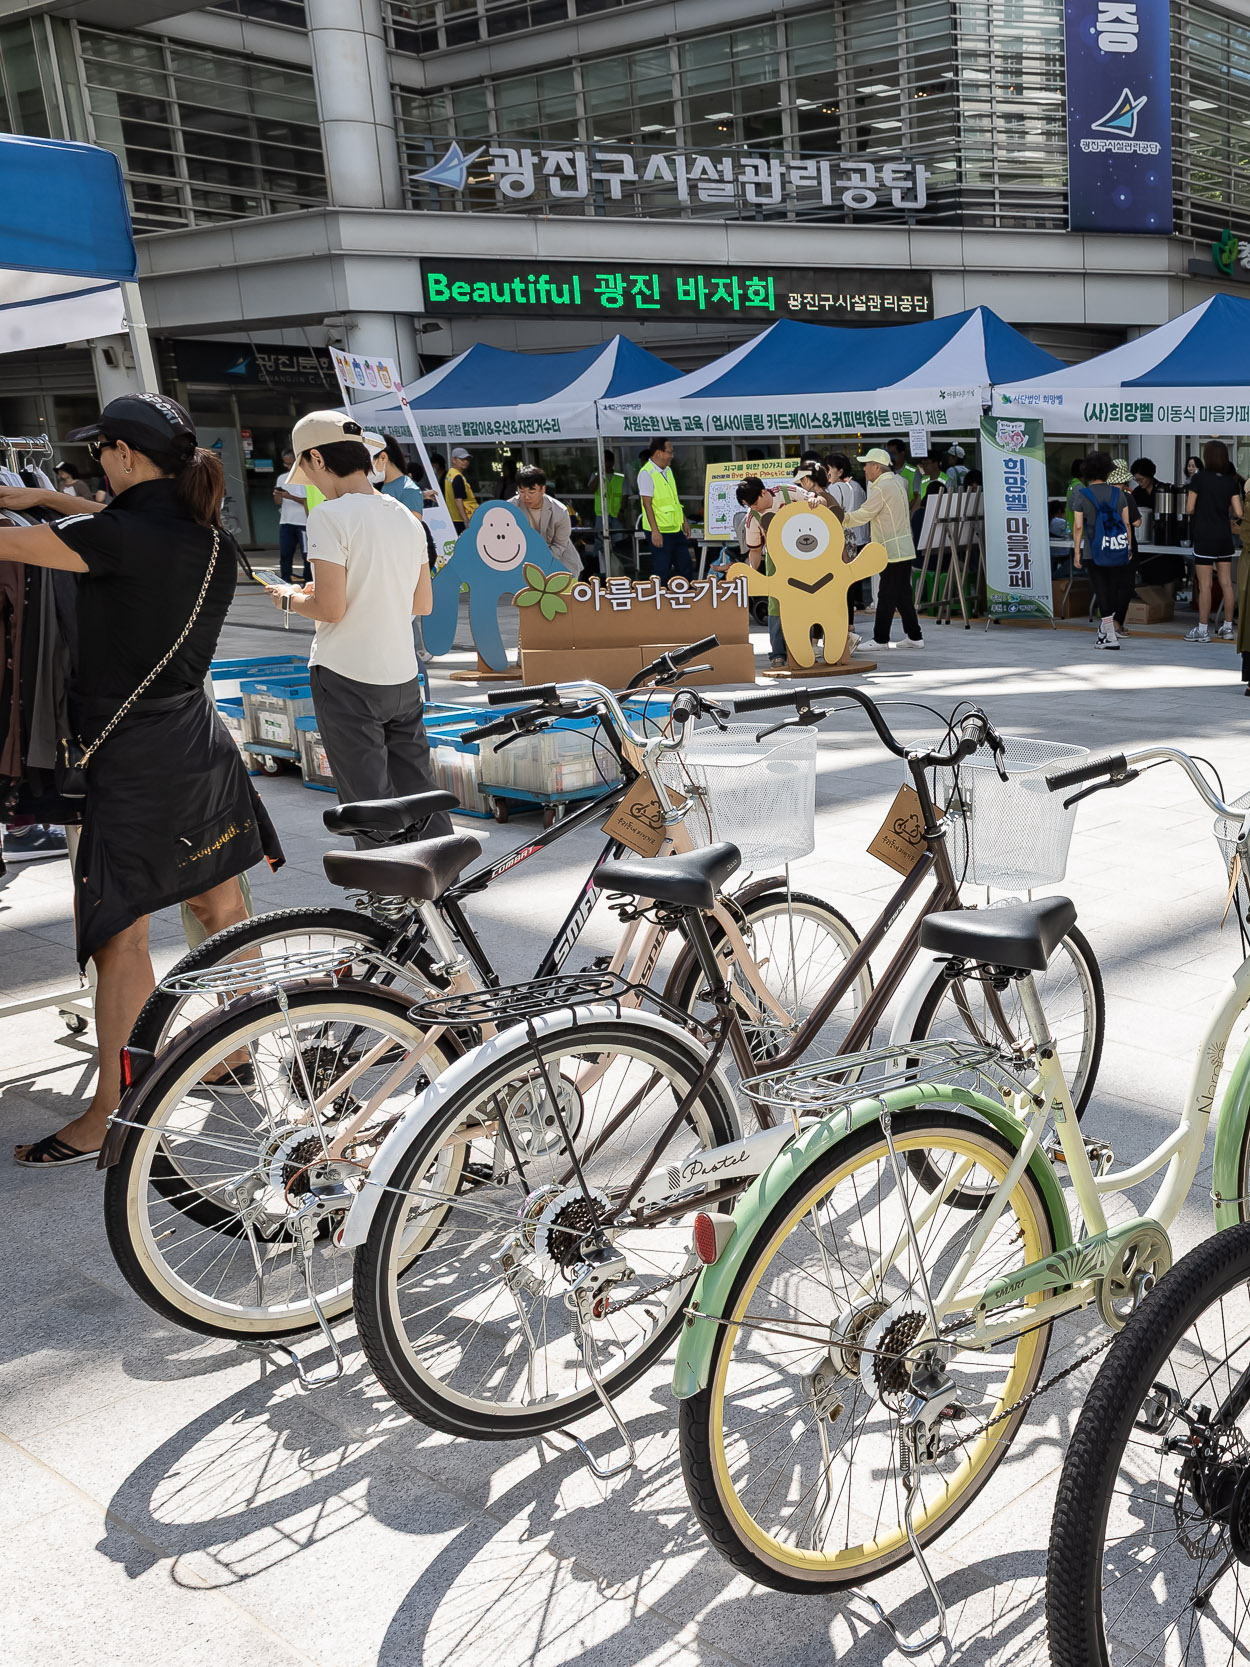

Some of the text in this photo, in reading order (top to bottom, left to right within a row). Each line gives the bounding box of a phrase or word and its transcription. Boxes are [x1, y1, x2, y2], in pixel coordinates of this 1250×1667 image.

[1081, 139, 1161, 155] 광진구시설관리공단
[488, 147, 931, 209] 광진구시설관리공단
[428, 272, 777, 312] Beautiful 광진 바자회
[787, 292, 929, 313] 광진구시설관리공단
[462, 418, 560, 434] 칼갈이&우산&자전거수리
[623, 415, 660, 432] 자원순환
[662, 415, 681, 432] 나눔
[684, 415, 704, 431] 교육
[711, 412, 765, 431] 업사이클링
[766, 409, 890, 430] 카드케이스&커피박화분
[892, 409, 924, 426] 만들기
[925, 408, 948, 425] 체험
[1083, 402, 1154, 423] (사)희망벨
[1157, 406, 1196, 423] 이동식
[723, 464, 743, 472] 지구를
[1003, 457, 1028, 512] 희망벨
[1006, 517, 1032, 589] 마을카페
[574, 575, 749, 611] 아름다운가게
[491, 845, 535, 879] COMBAT
[682, 1150, 750, 1183] Pastel
[994, 1277, 1027, 1299] SMART
